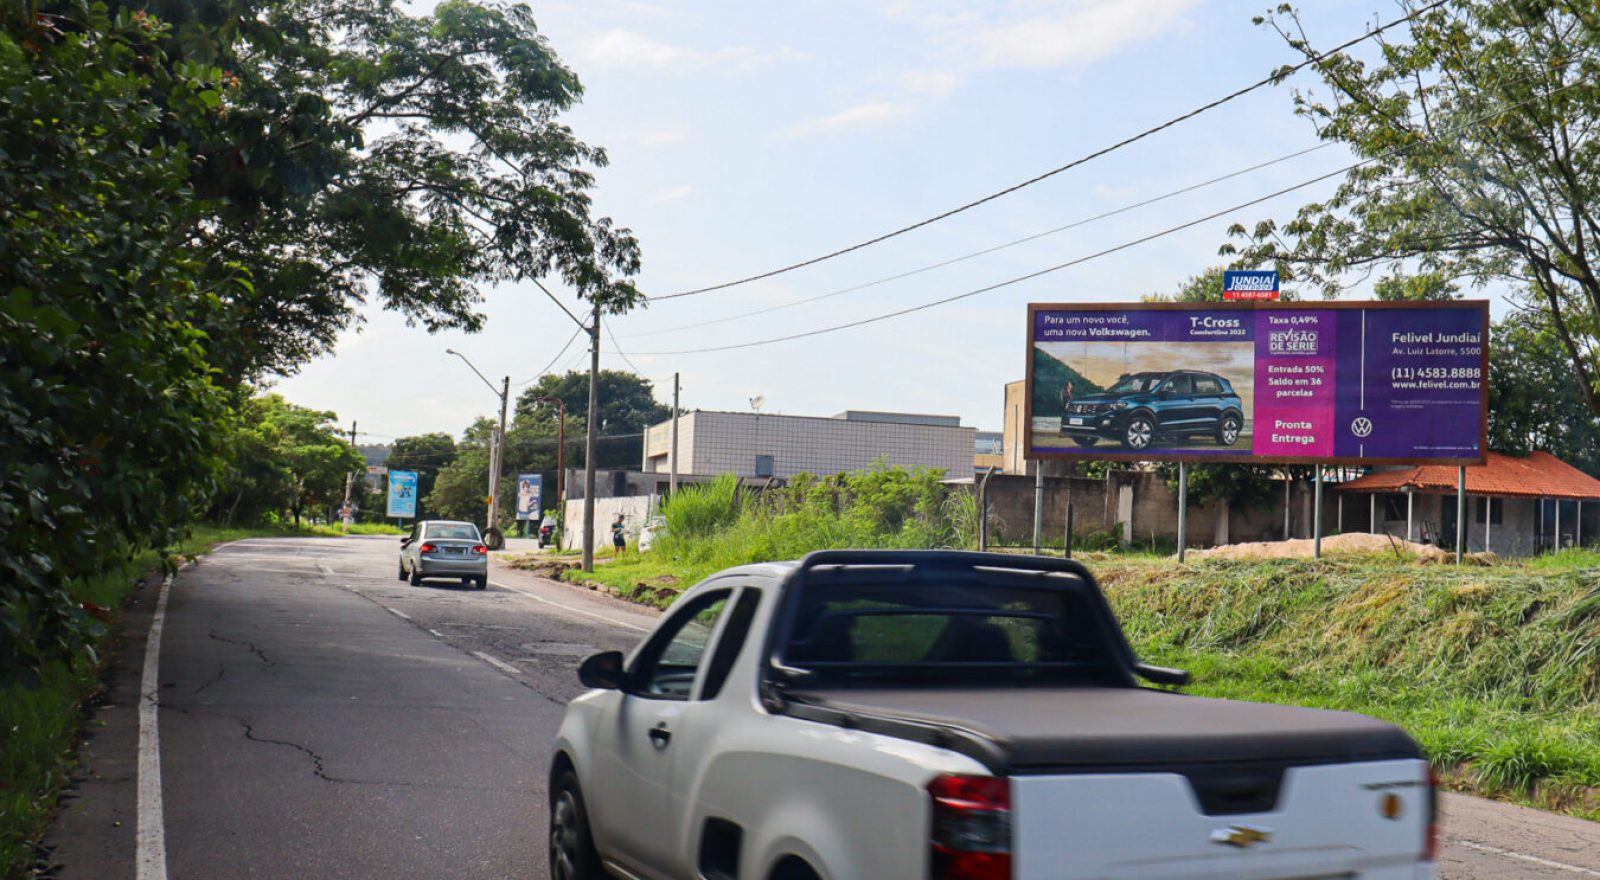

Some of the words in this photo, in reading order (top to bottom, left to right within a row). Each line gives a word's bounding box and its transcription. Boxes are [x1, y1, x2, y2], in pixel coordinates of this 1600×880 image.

[1227, 273, 1276, 290] JUNDIAÍ
[1044, 315, 1064, 324] Para
[1106, 315, 1129, 325] você,
[1189, 316, 1240, 328] T-Cross
[1269, 316, 1289, 324] Taxa
[1290, 316, 1318, 325] 0,49%
[1089, 328, 1151, 338] Volkswagen.
[1270, 329, 1317, 342] REVISÃO
[1392, 332, 1432, 343] Felivel
[1270, 341, 1284, 350] DE
[1392, 347, 1405, 355] Av.
[1407, 347, 1423, 355] Luiz
[1425, 347, 1458, 356] Latorre,
[1460, 347, 1481, 355] 5500
[1268, 365, 1303, 373] Entrada
[1305, 365, 1324, 373] 50%
[1391, 367, 1415, 380] (11)
[1417, 367, 1481, 379] 4583.8888
[1268, 377, 1293, 386] Saldo
[1310, 377, 1322, 386] 36
[1392, 381, 1480, 389] www.felivel.com.br
[1276, 389, 1313, 398] parcelas
[1275, 420, 1312, 429] Pronta
[1271, 433, 1315, 445] Entrega
